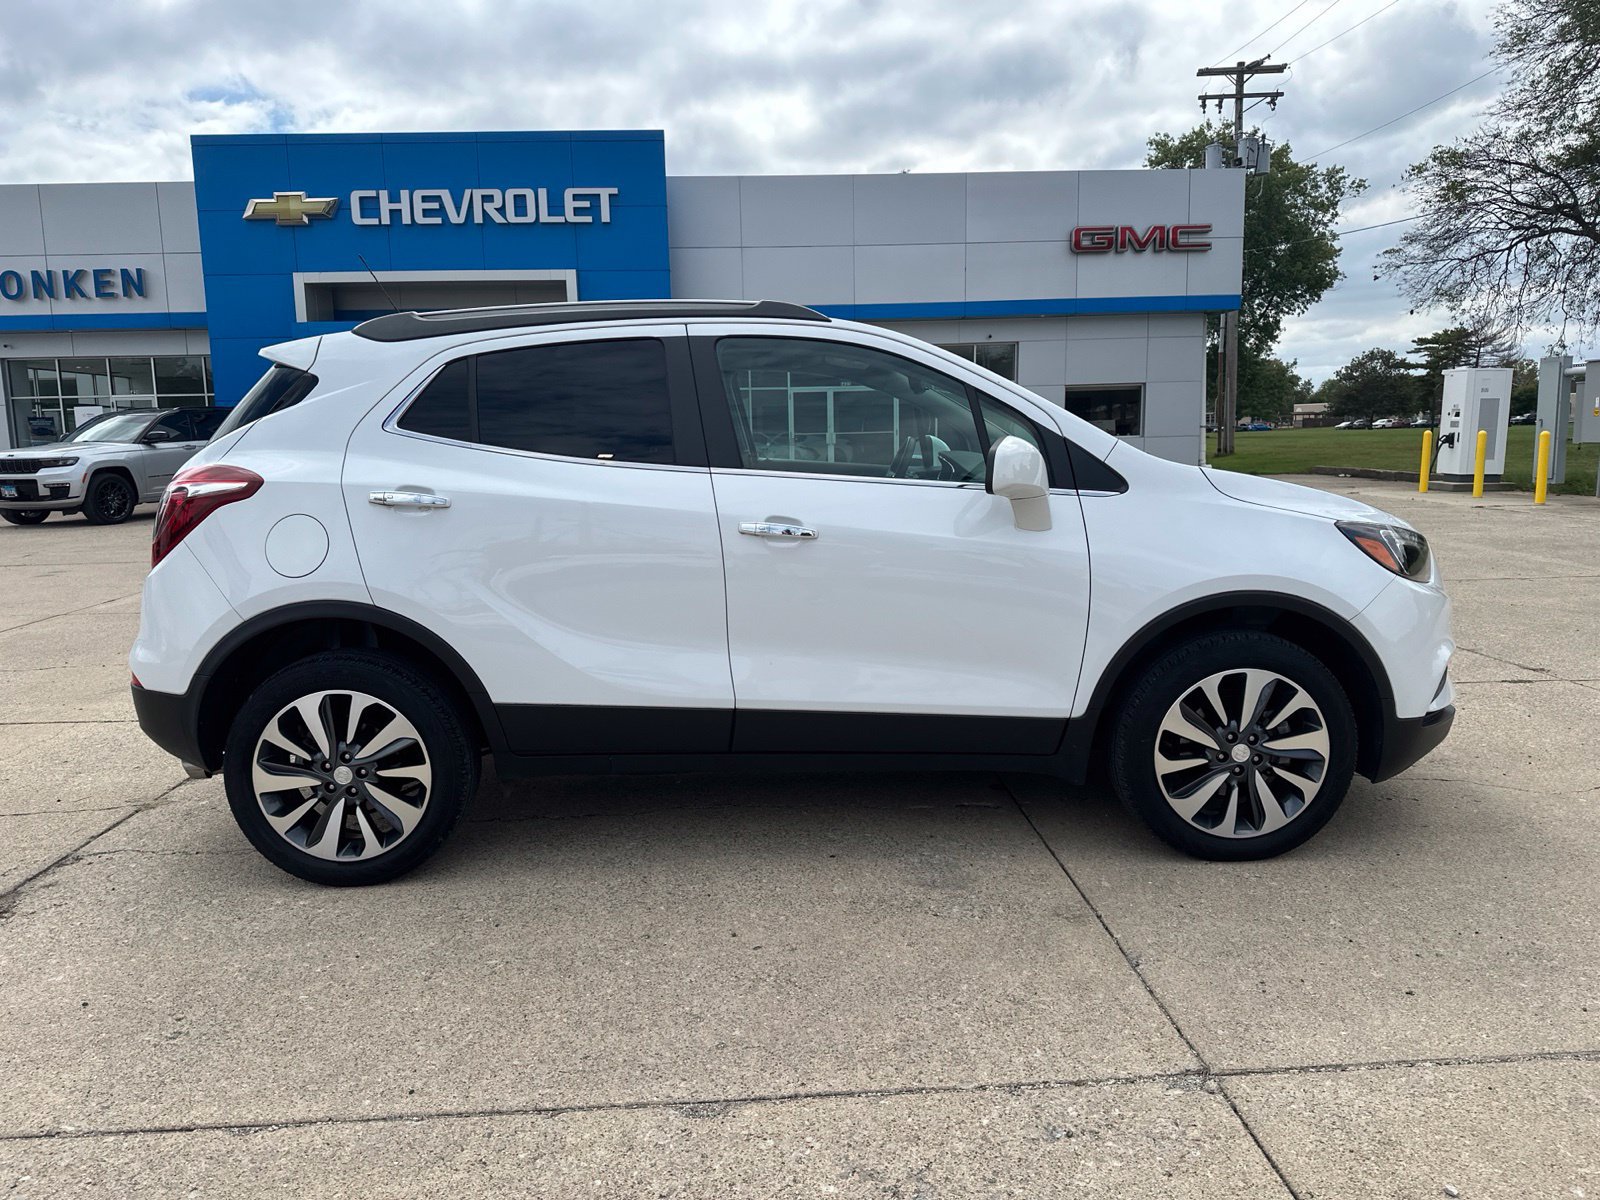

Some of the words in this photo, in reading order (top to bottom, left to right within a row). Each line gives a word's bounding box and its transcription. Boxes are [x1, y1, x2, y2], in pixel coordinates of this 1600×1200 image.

[350, 187, 619, 225] CHEVROLET
[1070, 223, 1213, 254] GMC
[0, 267, 147, 301] ONKEN
